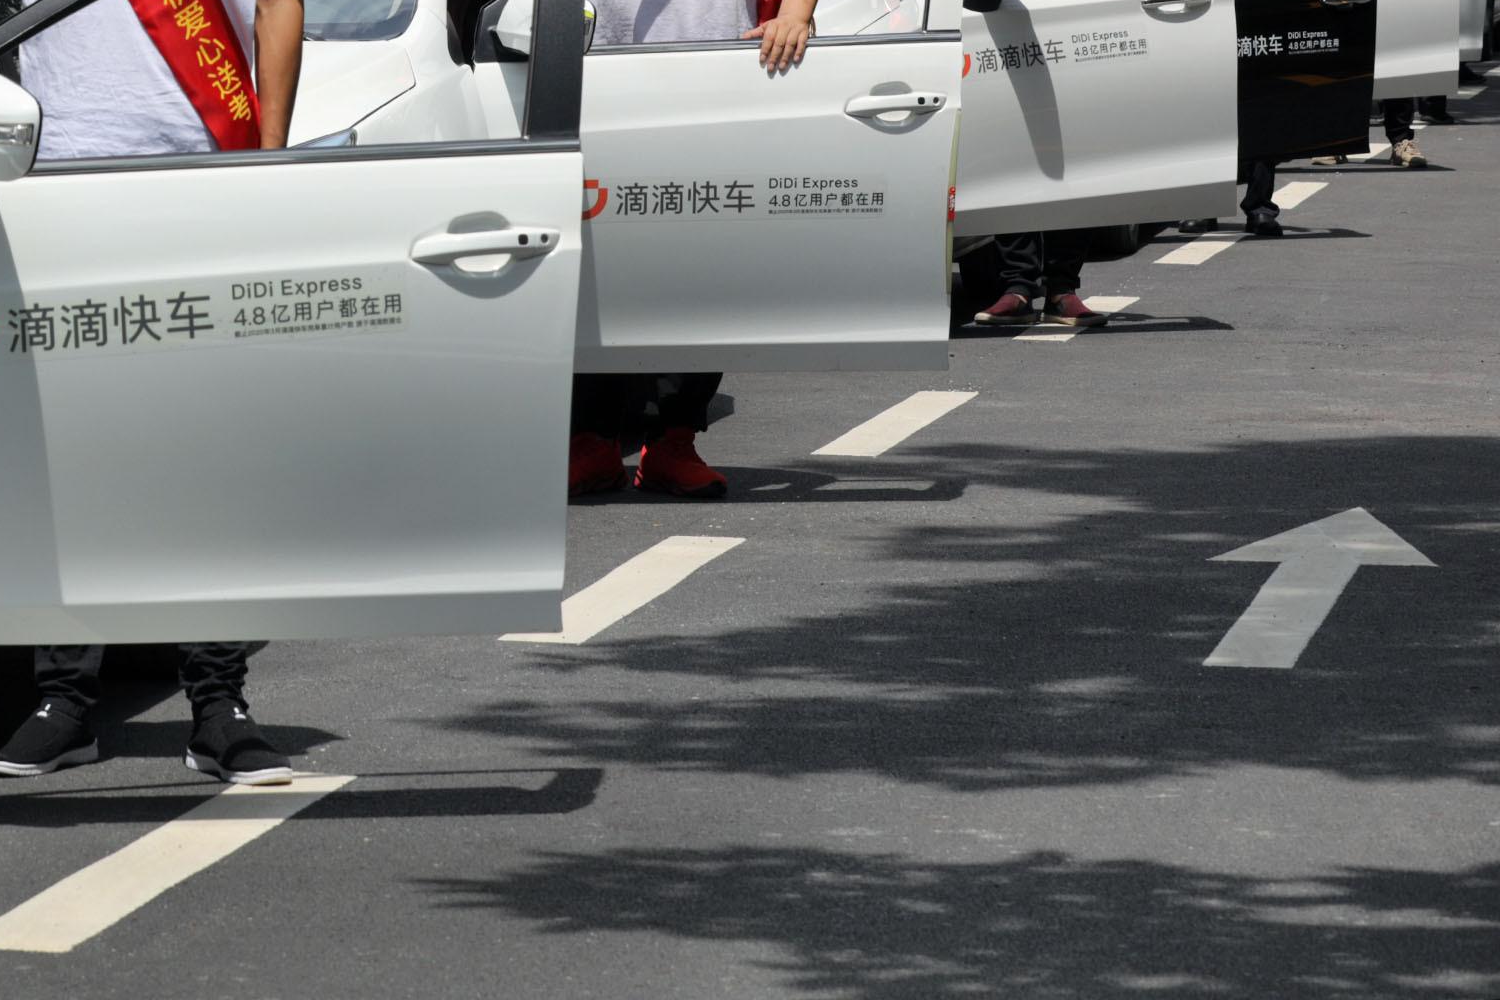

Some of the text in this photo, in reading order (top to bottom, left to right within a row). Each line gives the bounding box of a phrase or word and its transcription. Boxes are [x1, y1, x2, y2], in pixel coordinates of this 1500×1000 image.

[1071, 30, 1129, 44] DiDi Express
[1237, 34, 1283, 57] 滴快车
[1303, 30, 1328, 39] Express
[975, 39, 1066, 74] 滴滴快车
[1073, 38, 1148, 58] 4.8亿用户都在用
[768, 177, 859, 190] DiDi Express
[616, 180, 755, 216] 滴滴快车
[768, 192, 885, 208] 4.8亿用户都在用
[231, 276, 363, 300] DiDi Express
[233, 293, 402, 327] 4.8亿用户都在用
[7, 291, 214, 353] 滴滴快车
